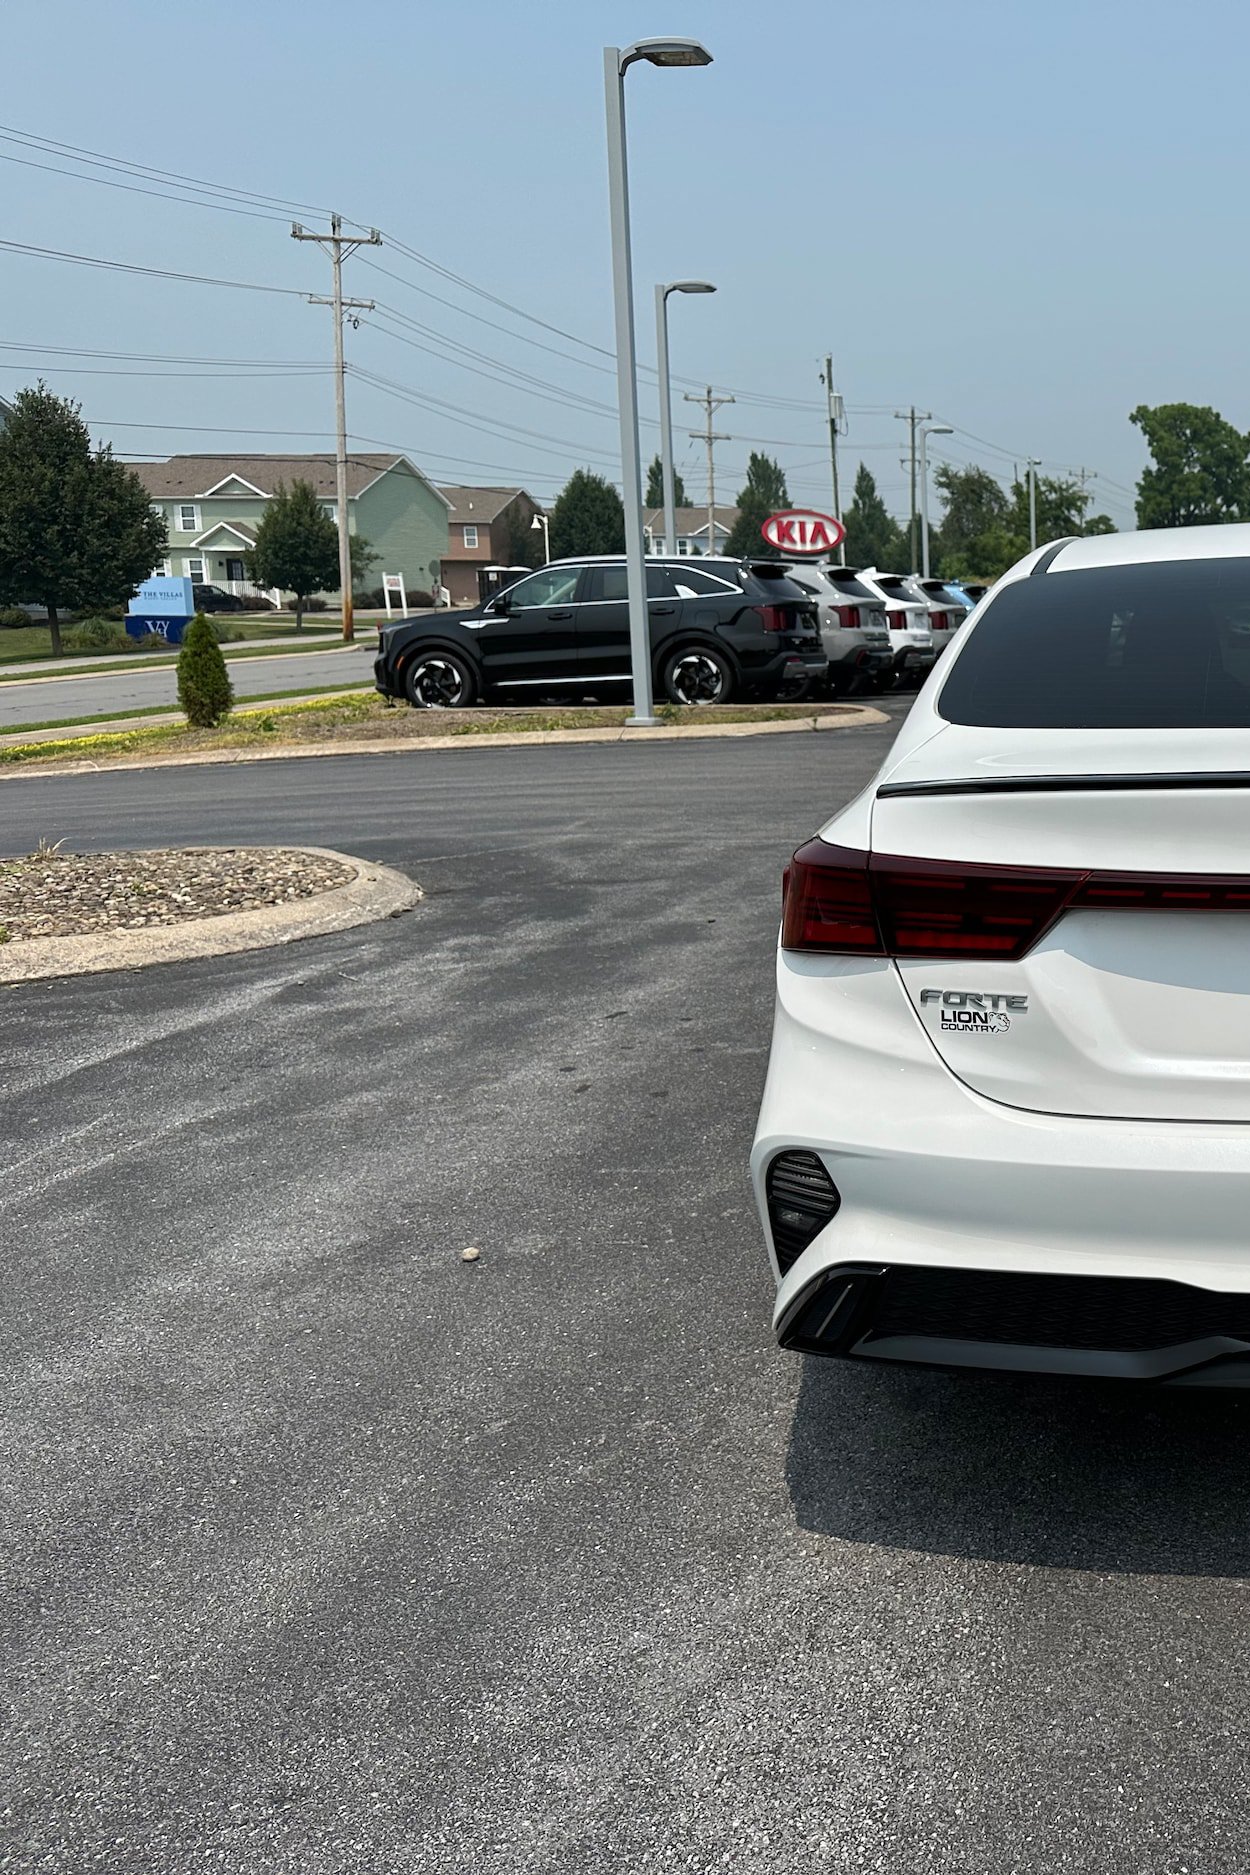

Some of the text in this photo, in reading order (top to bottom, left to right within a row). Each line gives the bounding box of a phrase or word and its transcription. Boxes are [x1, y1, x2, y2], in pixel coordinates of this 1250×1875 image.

[775, 520, 831, 545] KIA
[920, 988, 1028, 1012] FORTE
[941, 1009, 989, 1024] LION
[941, 1023, 998, 1034] COUNTRY
